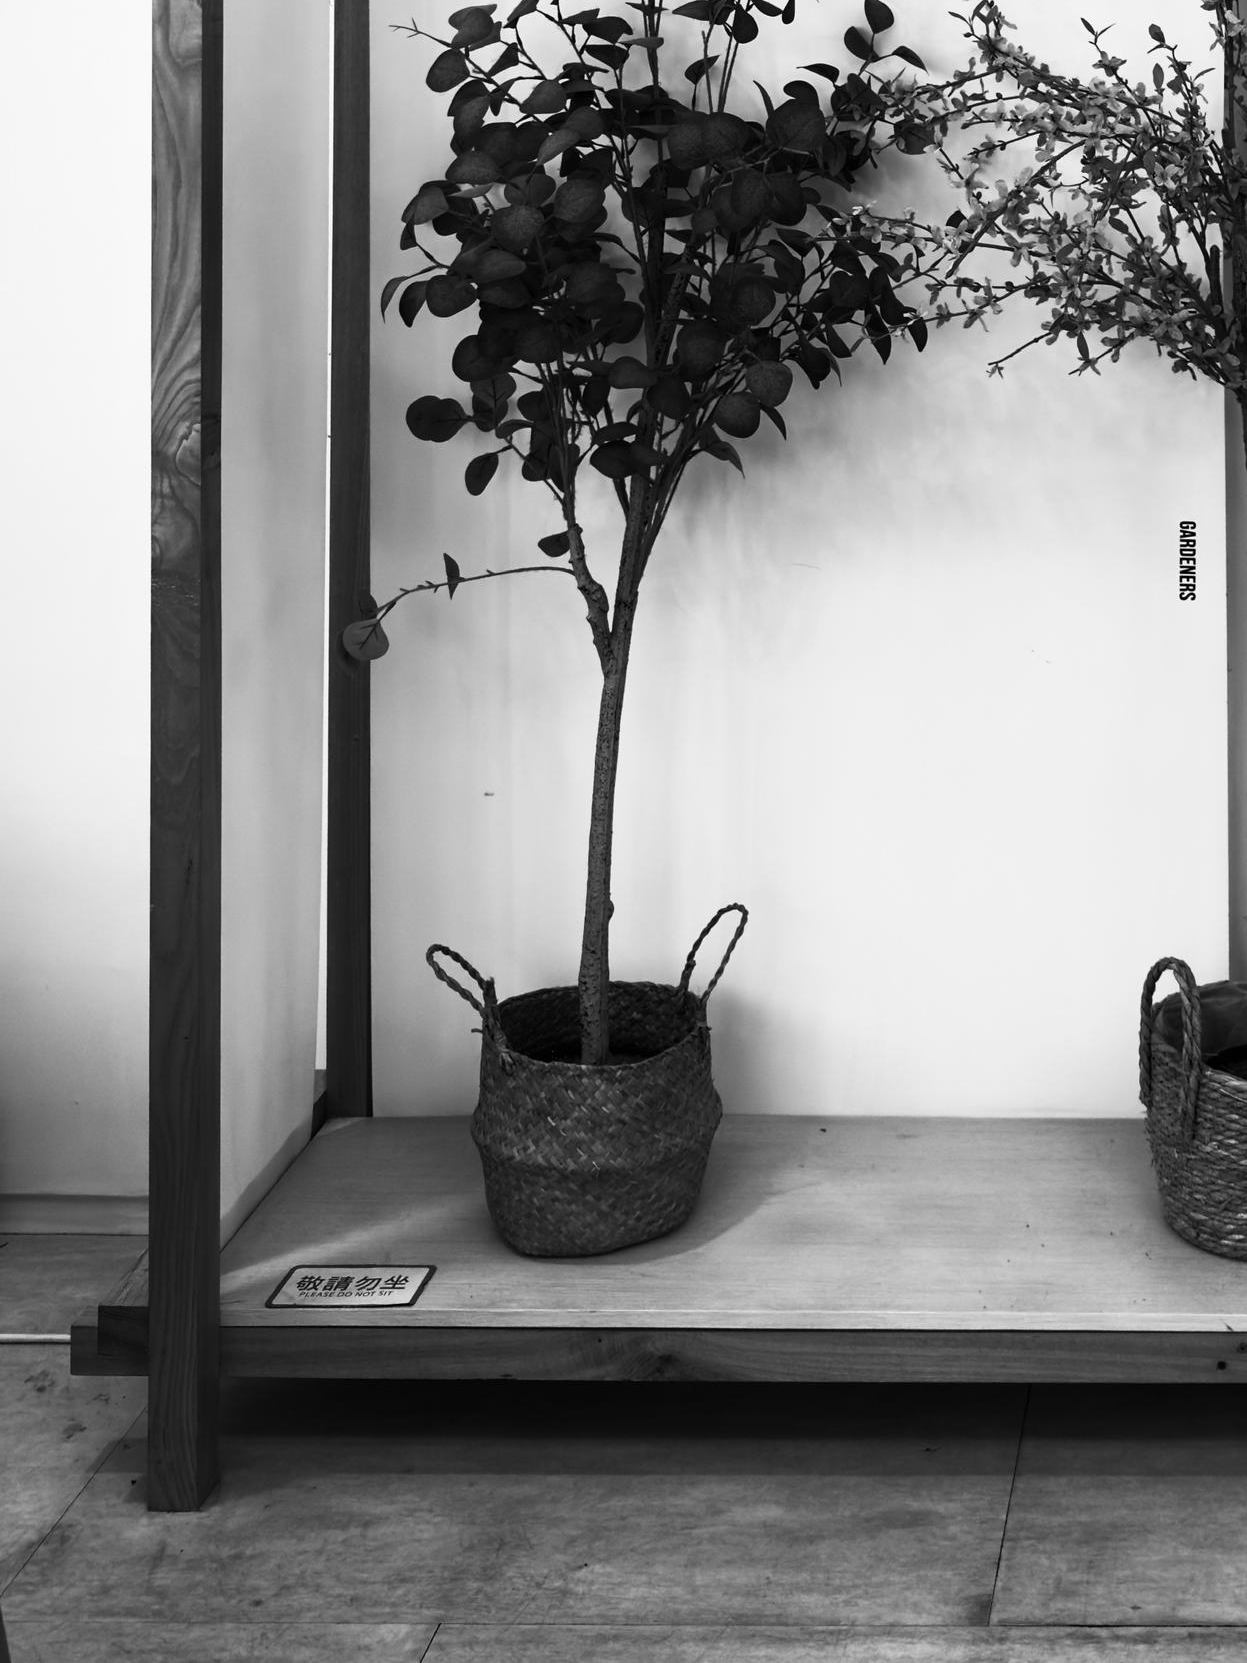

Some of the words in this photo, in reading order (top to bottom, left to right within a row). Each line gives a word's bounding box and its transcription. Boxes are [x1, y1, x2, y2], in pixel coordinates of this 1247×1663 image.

[1178, 520, 1197, 601] GARDENERS
[296, 1275, 409, 1291] 敬請勿坐
[355, 1290, 376, 1298] NOT
